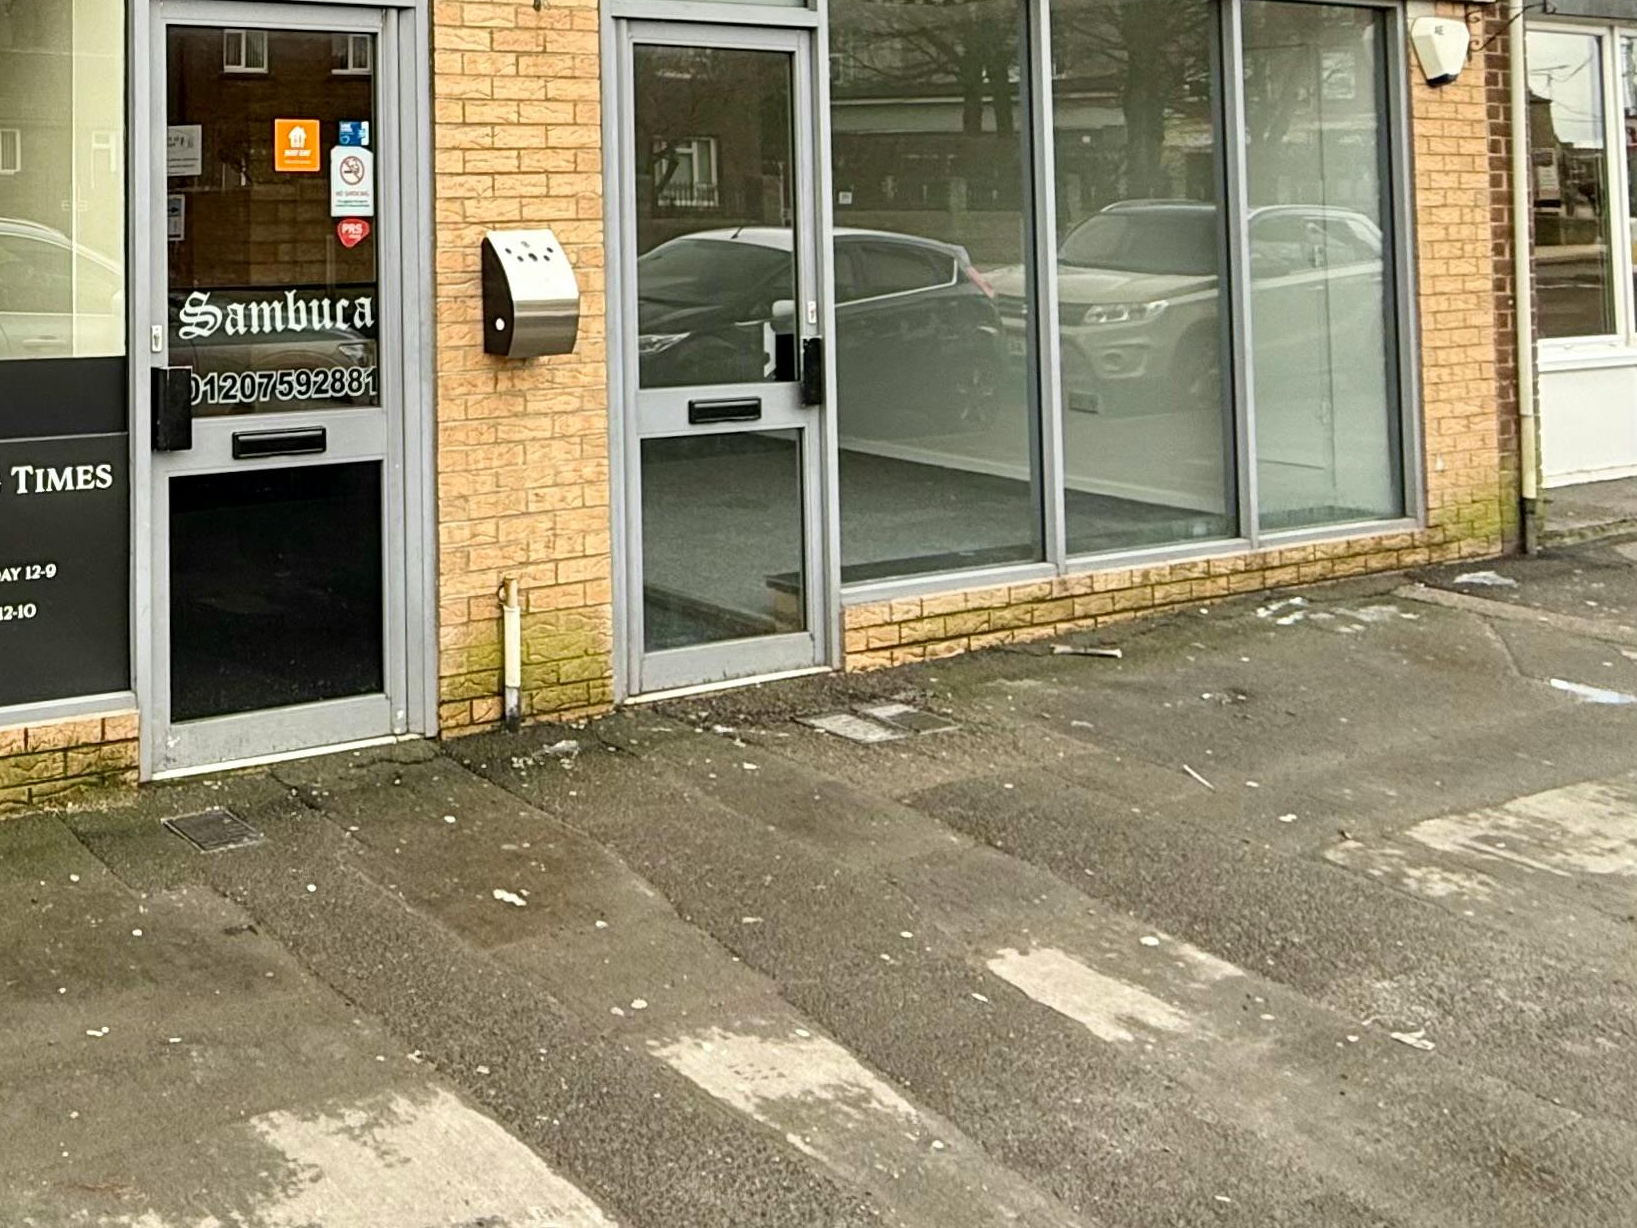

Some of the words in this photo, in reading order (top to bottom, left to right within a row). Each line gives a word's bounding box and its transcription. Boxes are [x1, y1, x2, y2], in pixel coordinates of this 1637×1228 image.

[178, 289, 376, 340] Sambuca
[10, 464, 114, 495] TIMES
[24, 563, 58, 581] 12-9
